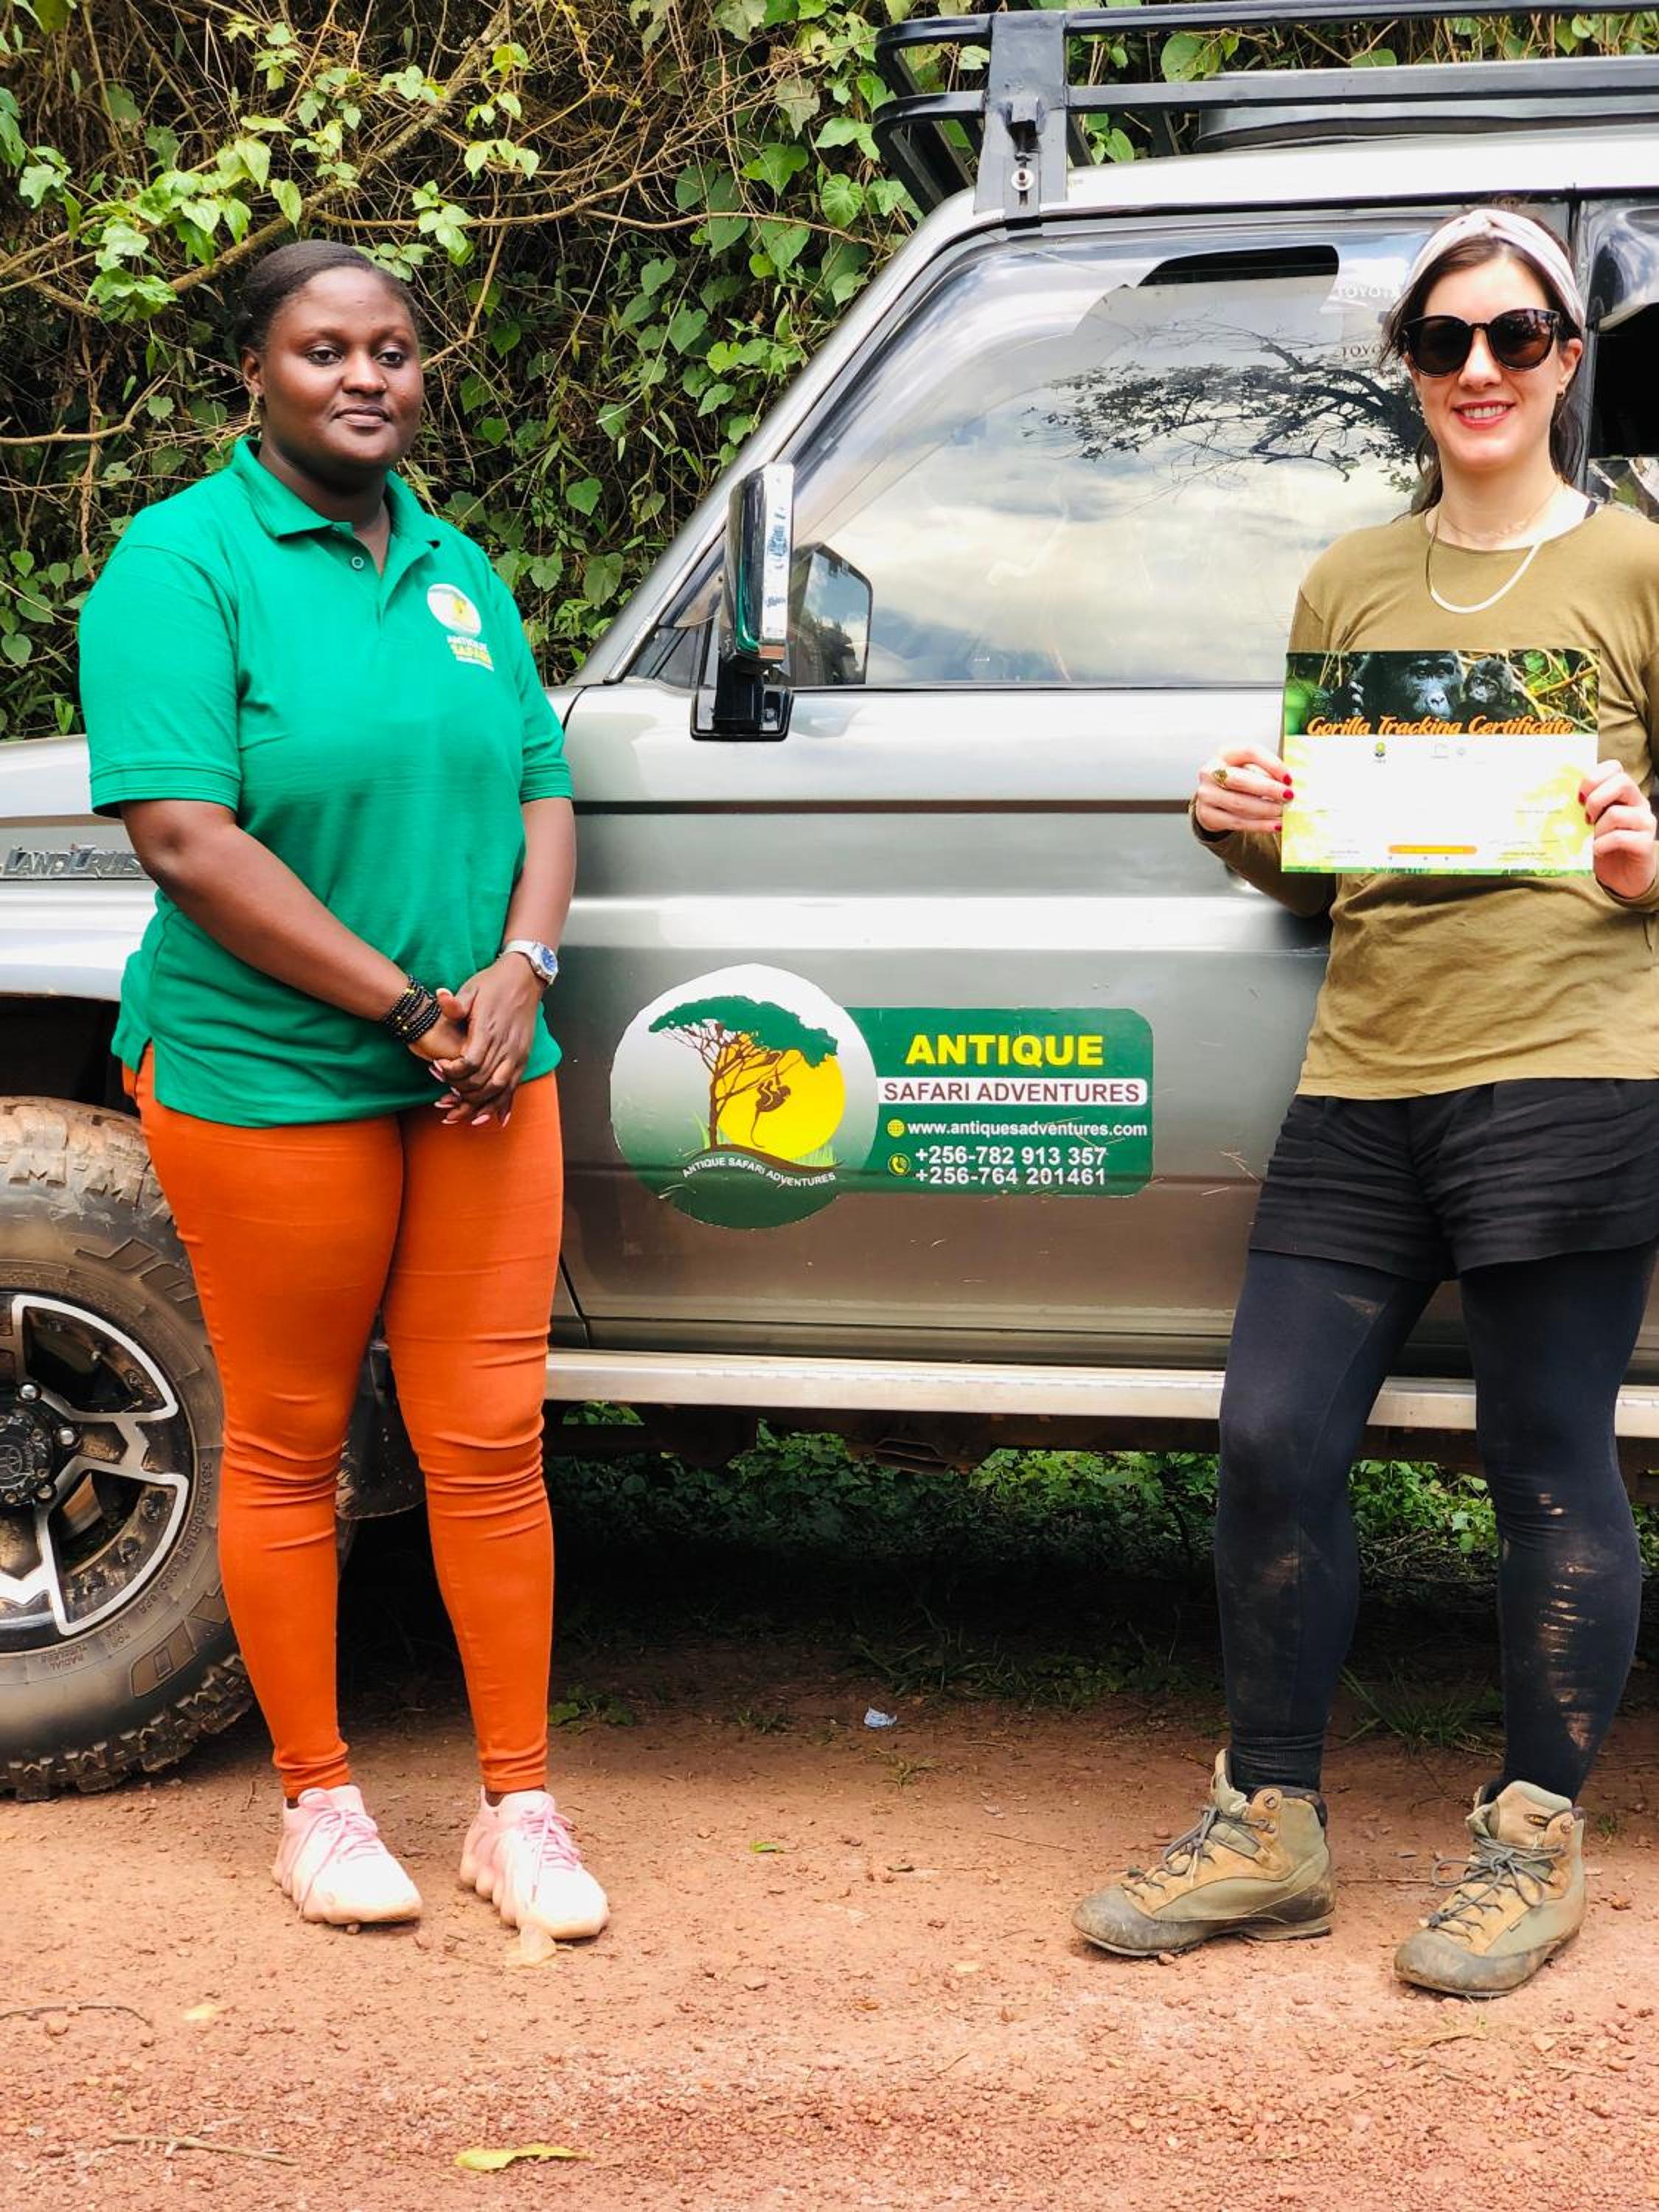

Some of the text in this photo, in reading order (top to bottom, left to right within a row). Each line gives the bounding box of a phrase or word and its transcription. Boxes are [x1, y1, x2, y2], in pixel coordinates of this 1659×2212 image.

[1306, 715, 1371, 735] Gorilla
[1467, 714, 1574, 735] Certificate
[905, 1034, 1104, 1068] ANTIQUE
[884, 1082, 1140, 1103] SAFARI ADVENTURES
[907, 1120, 1148, 1138] www.antiquesadventures.com
[915, 1145, 1107, 1166] +256-782 913 357
[681, 1157, 837, 1188] ANTIQUE SAFARI ADVENTURES
[915, 1166, 1106, 1186] +256-764 201461
